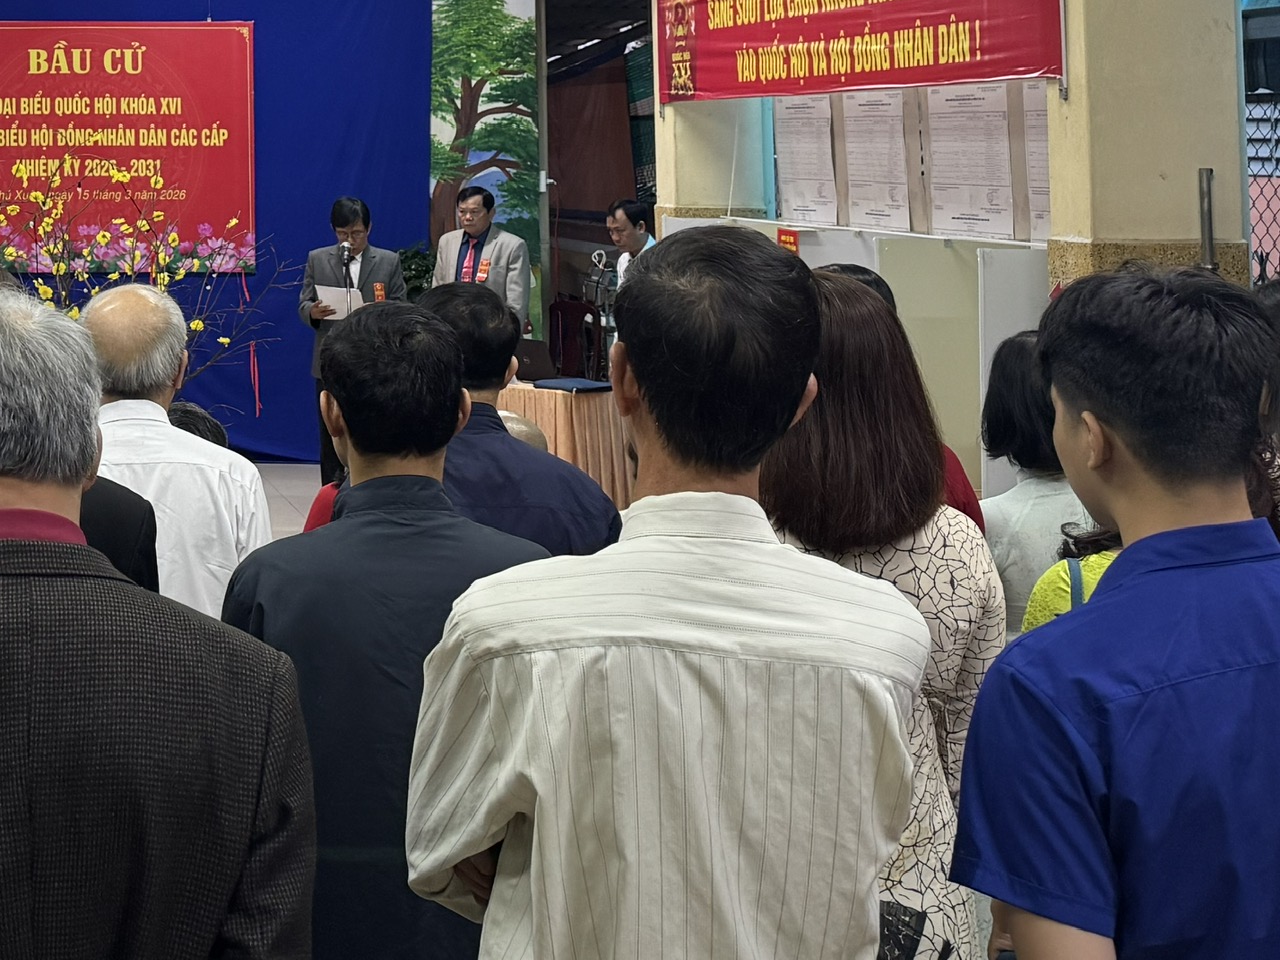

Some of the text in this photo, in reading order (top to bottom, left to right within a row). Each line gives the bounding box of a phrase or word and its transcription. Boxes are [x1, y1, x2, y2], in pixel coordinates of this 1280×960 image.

[28, 40, 147, 75] BẦU CỬ
[758, 33, 787, 84] QUỐC
[788, 35, 809, 85] HỘI
[810, 33, 827, 76] VÀ
[829, 30, 851, 82] HỘI
[853, 21, 890, 73] ĐỒNG
[894, 19, 934, 69] NHÂN
[938, 14, 970, 64] DÂN
[20, 90, 51, 115] BIỂU
[55, 91, 90, 117] QUỐC
[94, 93, 117, 118] HỘI
[120, 94, 156, 115] KHÓA
[160, 97, 182, 115] XVI
[31, 123, 53, 150] HỘI
[57, 121, 94, 146] ĐỒNG
[98, 123, 135, 146] NHÂN
[140, 123, 167, 146] DÂN
[171, 123, 198, 146] CÁC
[201, 120, 229, 146] CẤP
[124, 190, 132, 200] 3
[160, 190, 186, 200] 2026
